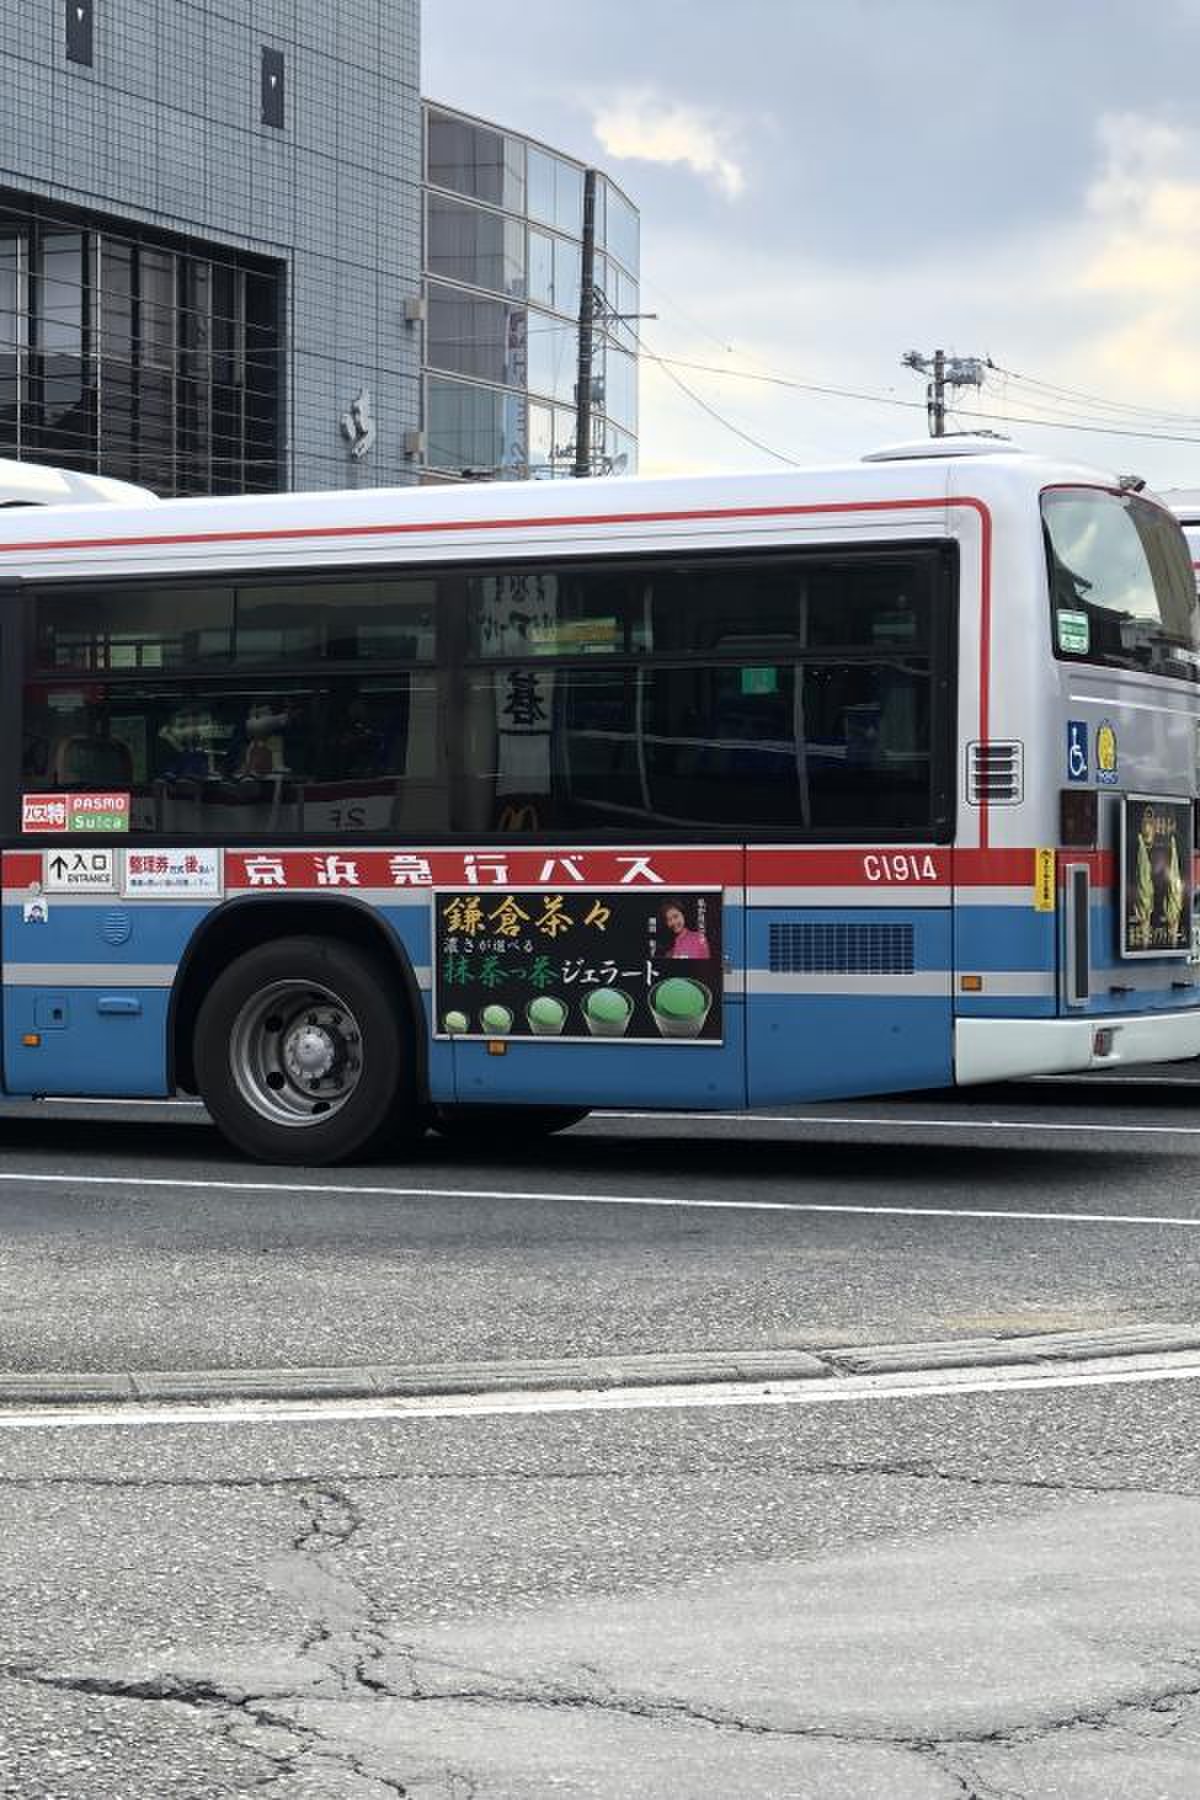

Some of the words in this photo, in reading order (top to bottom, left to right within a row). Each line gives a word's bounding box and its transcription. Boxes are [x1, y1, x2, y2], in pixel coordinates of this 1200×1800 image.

[73, 797, 125, 811] PASMO
[74, 815, 122, 830] Suica
[73, 854, 107, 871] 入口
[243, 854, 666, 886] 京浜急行バス
[863, 855, 938, 882] C1914
[67, 873, 111, 883] ENTRANCE
[442, 895, 614, 938] 鎌倉茶々
[442, 938, 535, 954] 濃さが選べる
